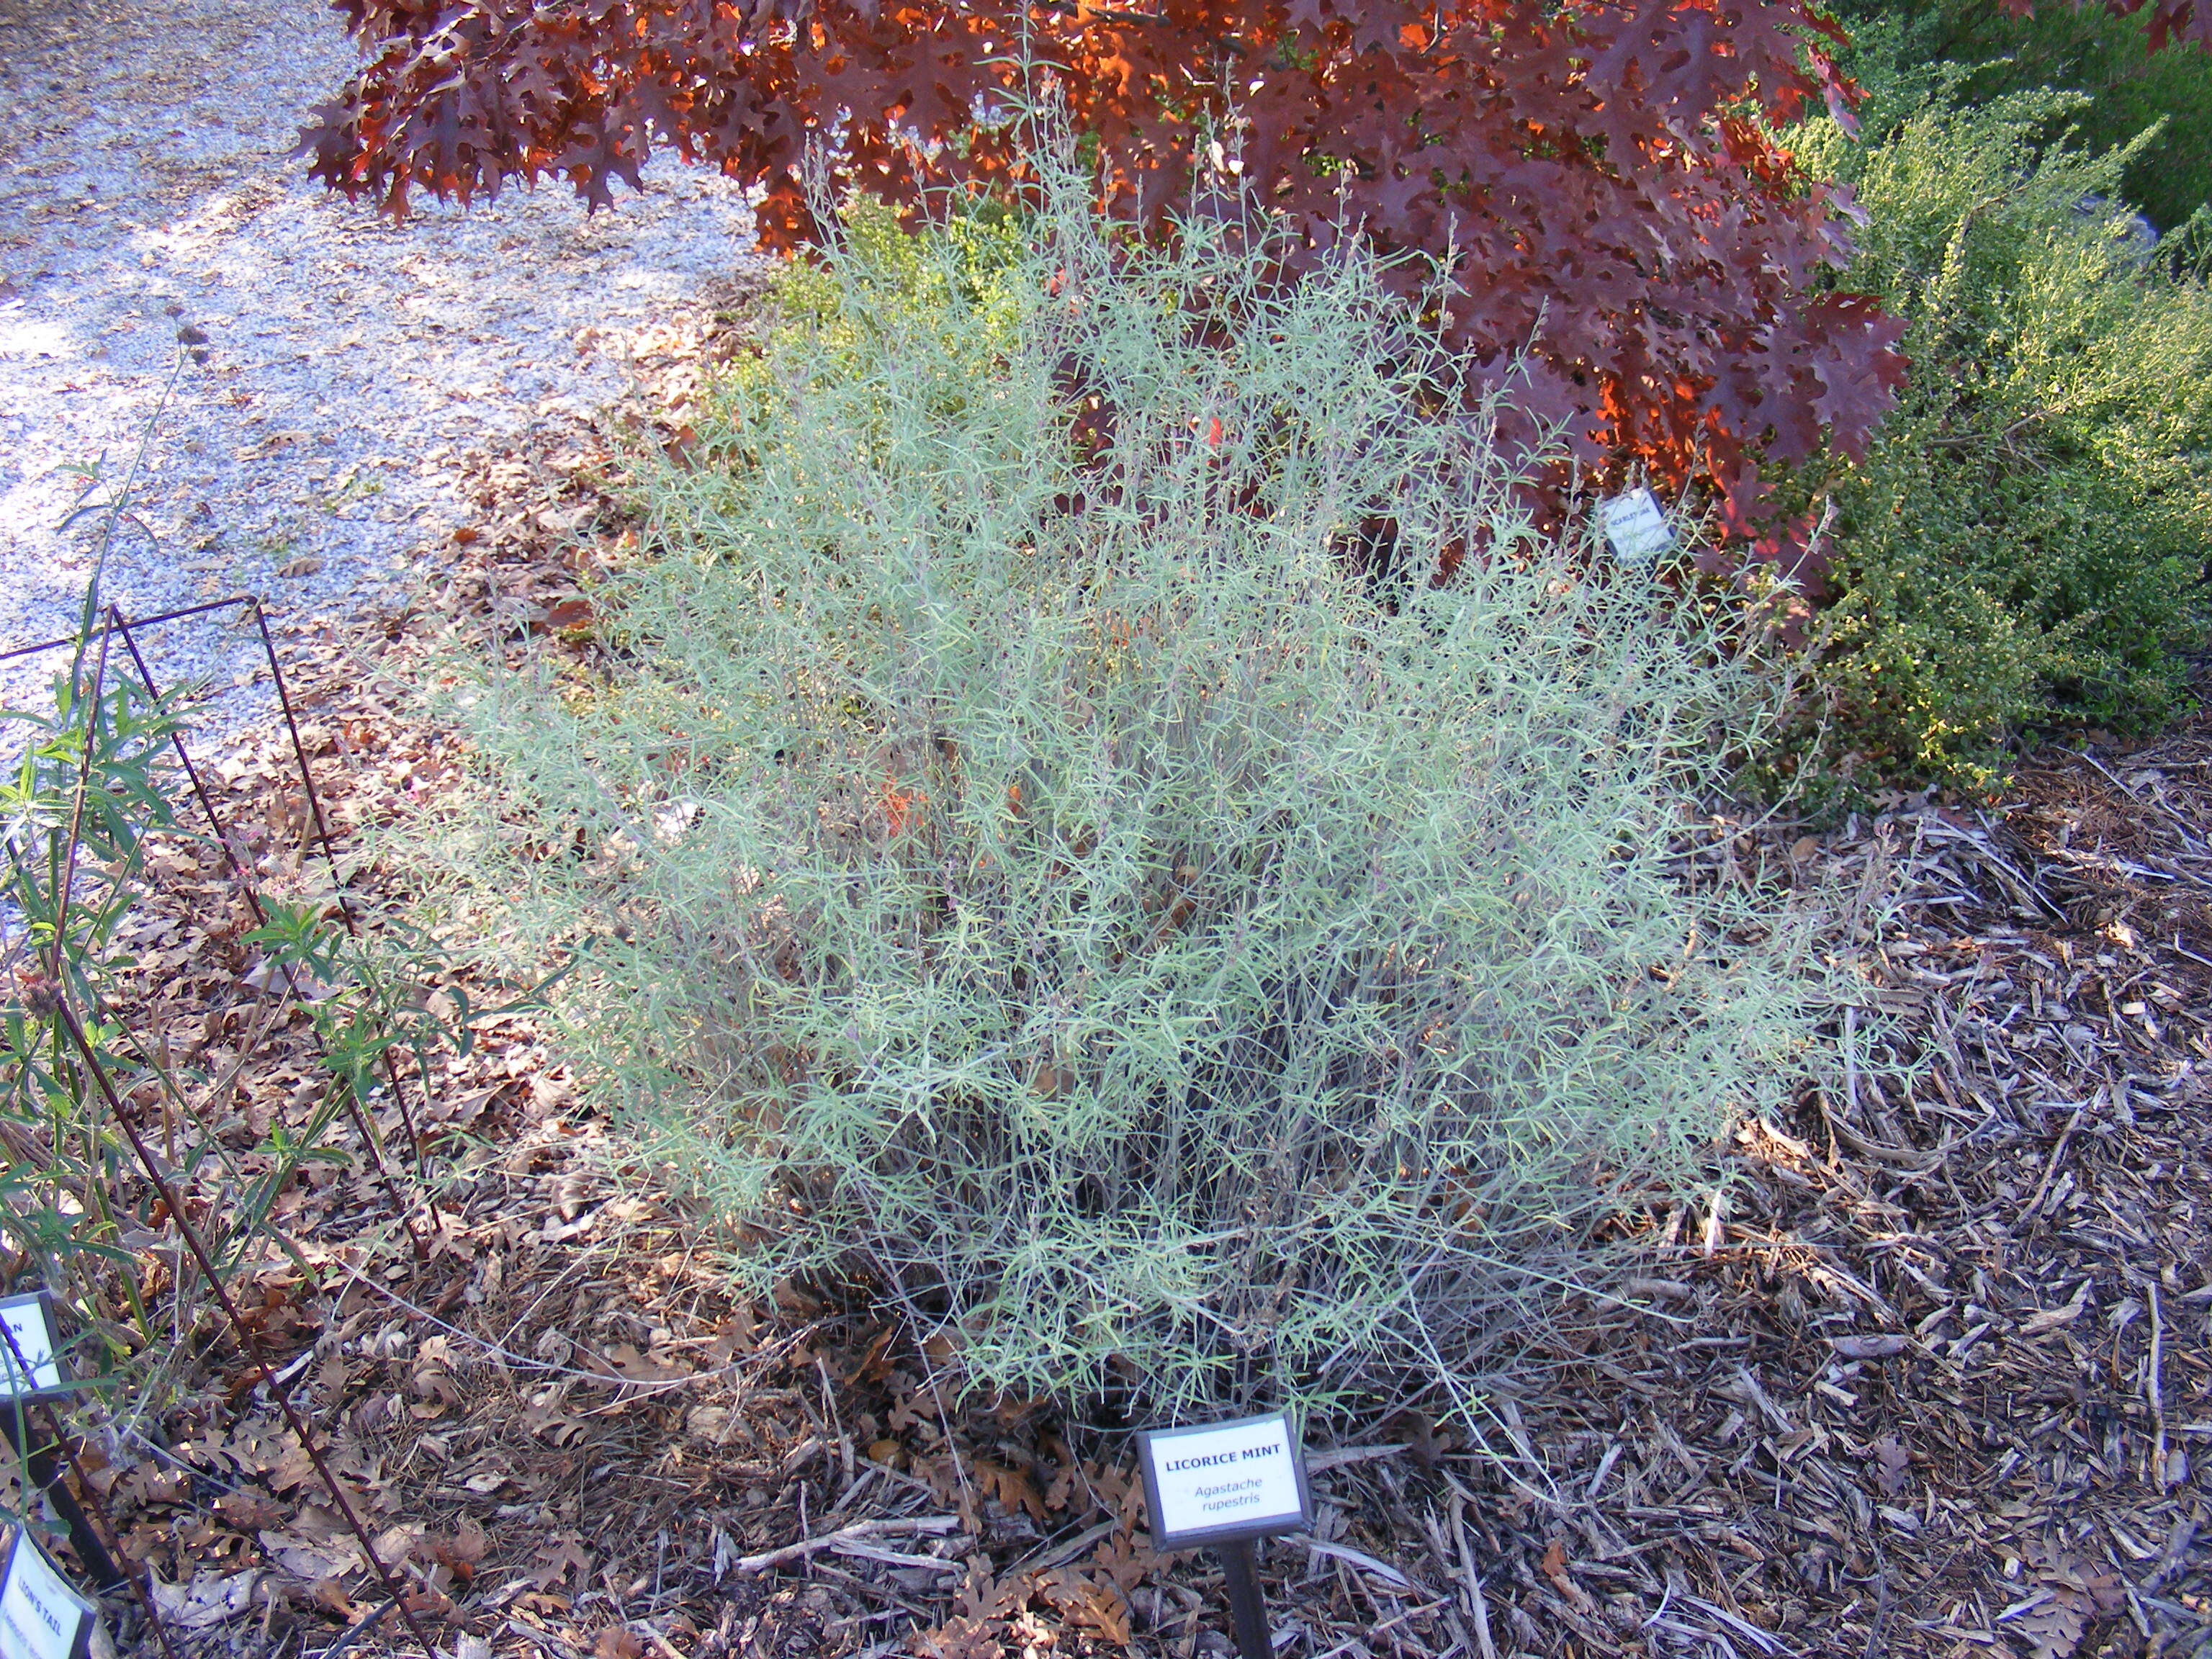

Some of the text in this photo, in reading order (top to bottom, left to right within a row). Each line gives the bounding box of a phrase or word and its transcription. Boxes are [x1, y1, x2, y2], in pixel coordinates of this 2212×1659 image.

[1166, 1444, 1281, 1471] LICORICE MINT
[1195, 1478, 1262, 1498] Agastache
[1202, 1493, 1260, 1511] rupestris
[18, 1576, 41, 1612] LION'S
[43, 1606, 61, 1637] TAIL
